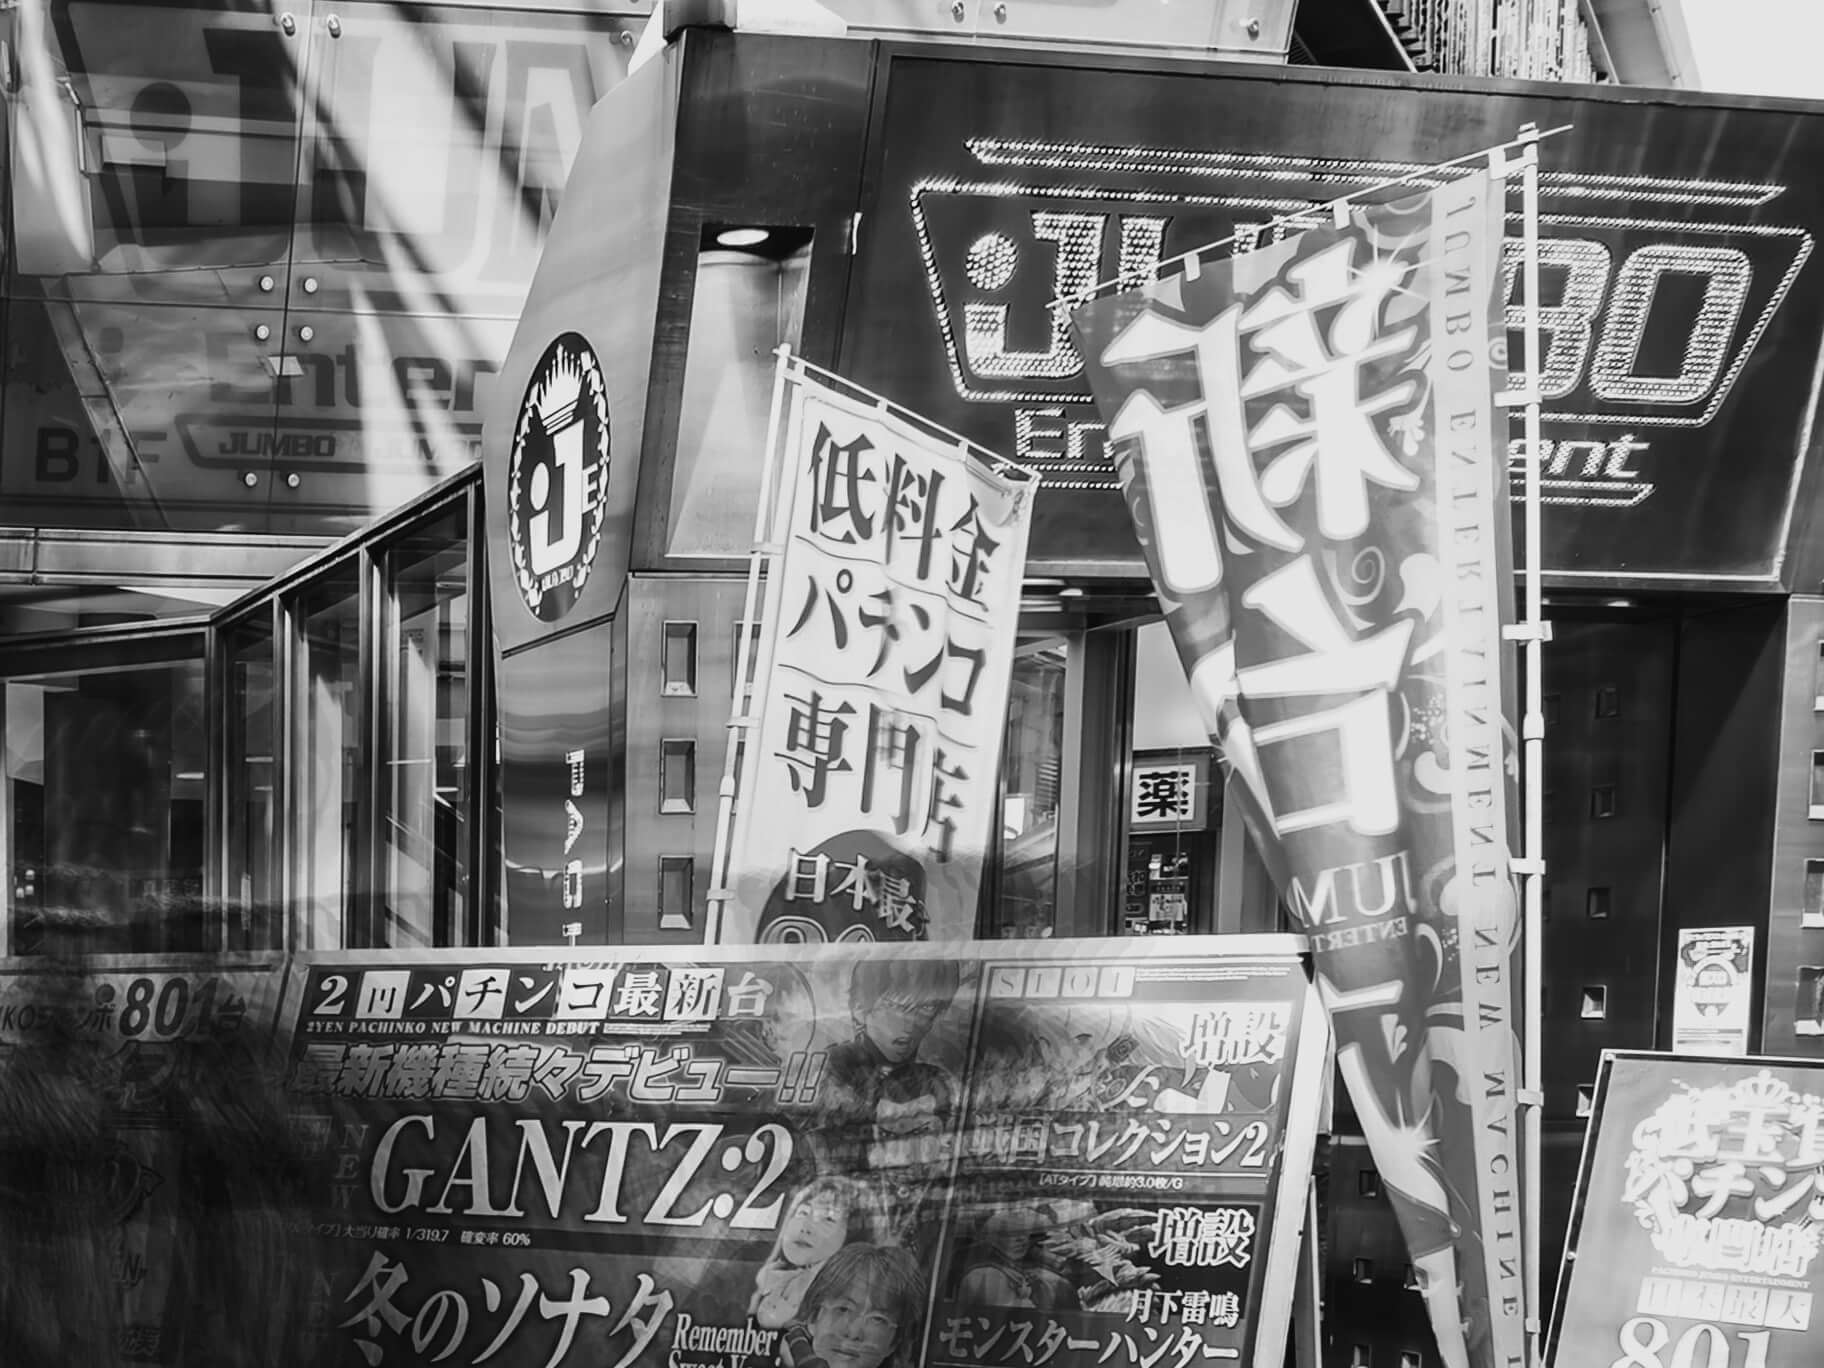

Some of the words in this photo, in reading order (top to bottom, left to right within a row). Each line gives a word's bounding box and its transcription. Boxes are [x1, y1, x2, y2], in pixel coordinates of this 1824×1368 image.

[218, 431, 336, 459] JUMBO
[807, 421, 1000, 606] 低料金
[786, 569, 986, 719] パチンコ
[784, 690, 980, 864] 専門店
[1136, 770, 1191, 818] 薬
[306, 1020, 344, 1034] 2YEN
[347, 1021, 426, 1035] PACHINKO
[430, 1021, 462, 1035] NEW
[466, 1021, 541, 1036] MACHINE
[544, 1022, 601, 1037] DEBUT
[370, 1112, 796, 1231] GANTZ:2
[502, 1232, 532, 1247] 60%
[1147, 1207, 1257, 1269] 増設
[1123, 1287, 1242, 1329] 月下雷鳴
[670, 1312, 778, 1358] Remember
